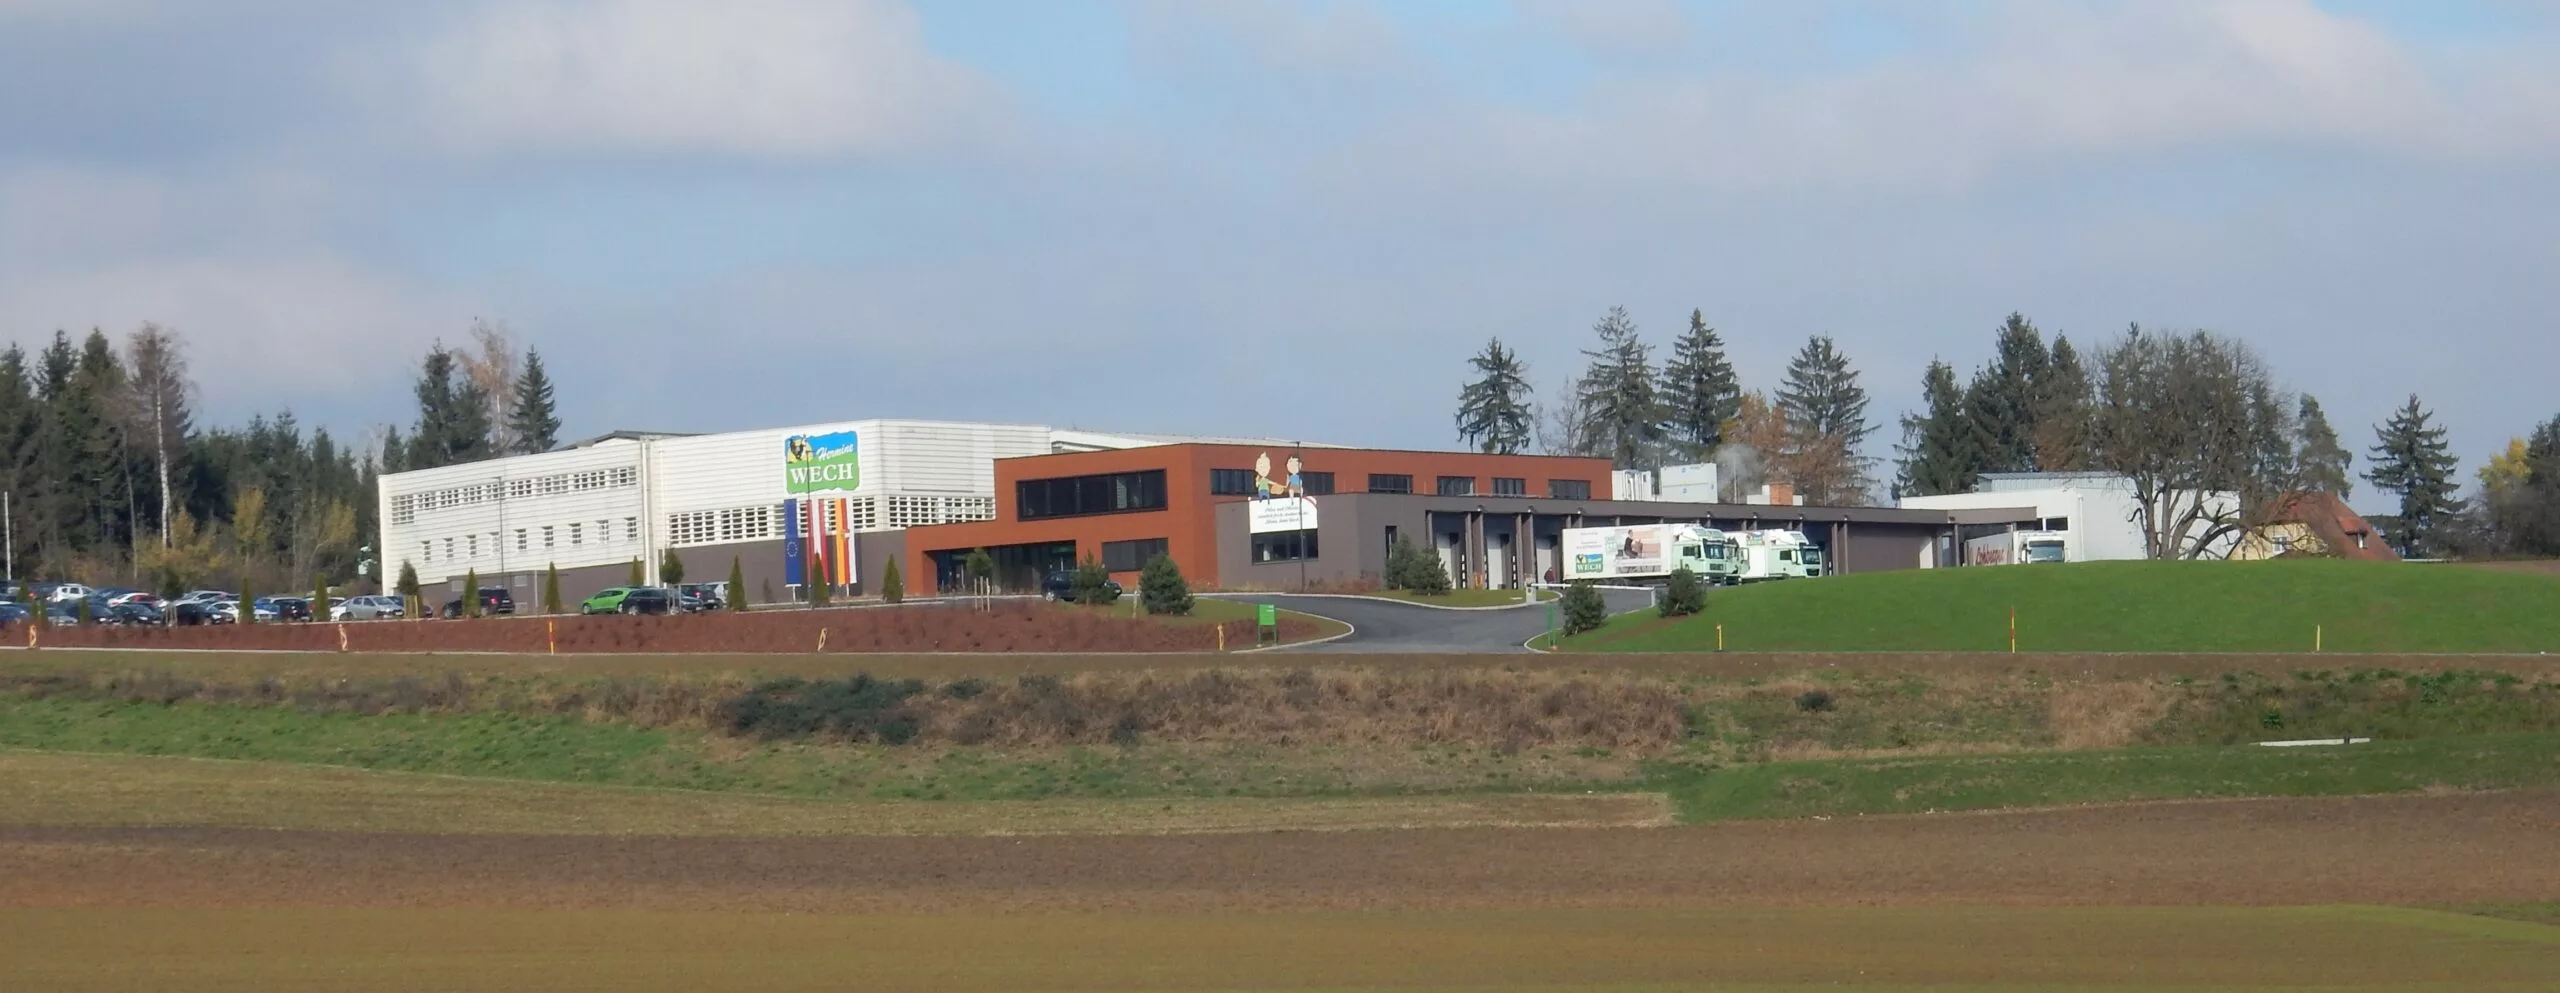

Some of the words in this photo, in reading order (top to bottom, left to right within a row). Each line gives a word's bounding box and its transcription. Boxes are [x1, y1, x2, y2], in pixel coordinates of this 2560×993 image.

[816, 444, 854, 461] Hermine
[790, 463, 854, 484] WECH
[1577, 562, 1602, 571] WECH
